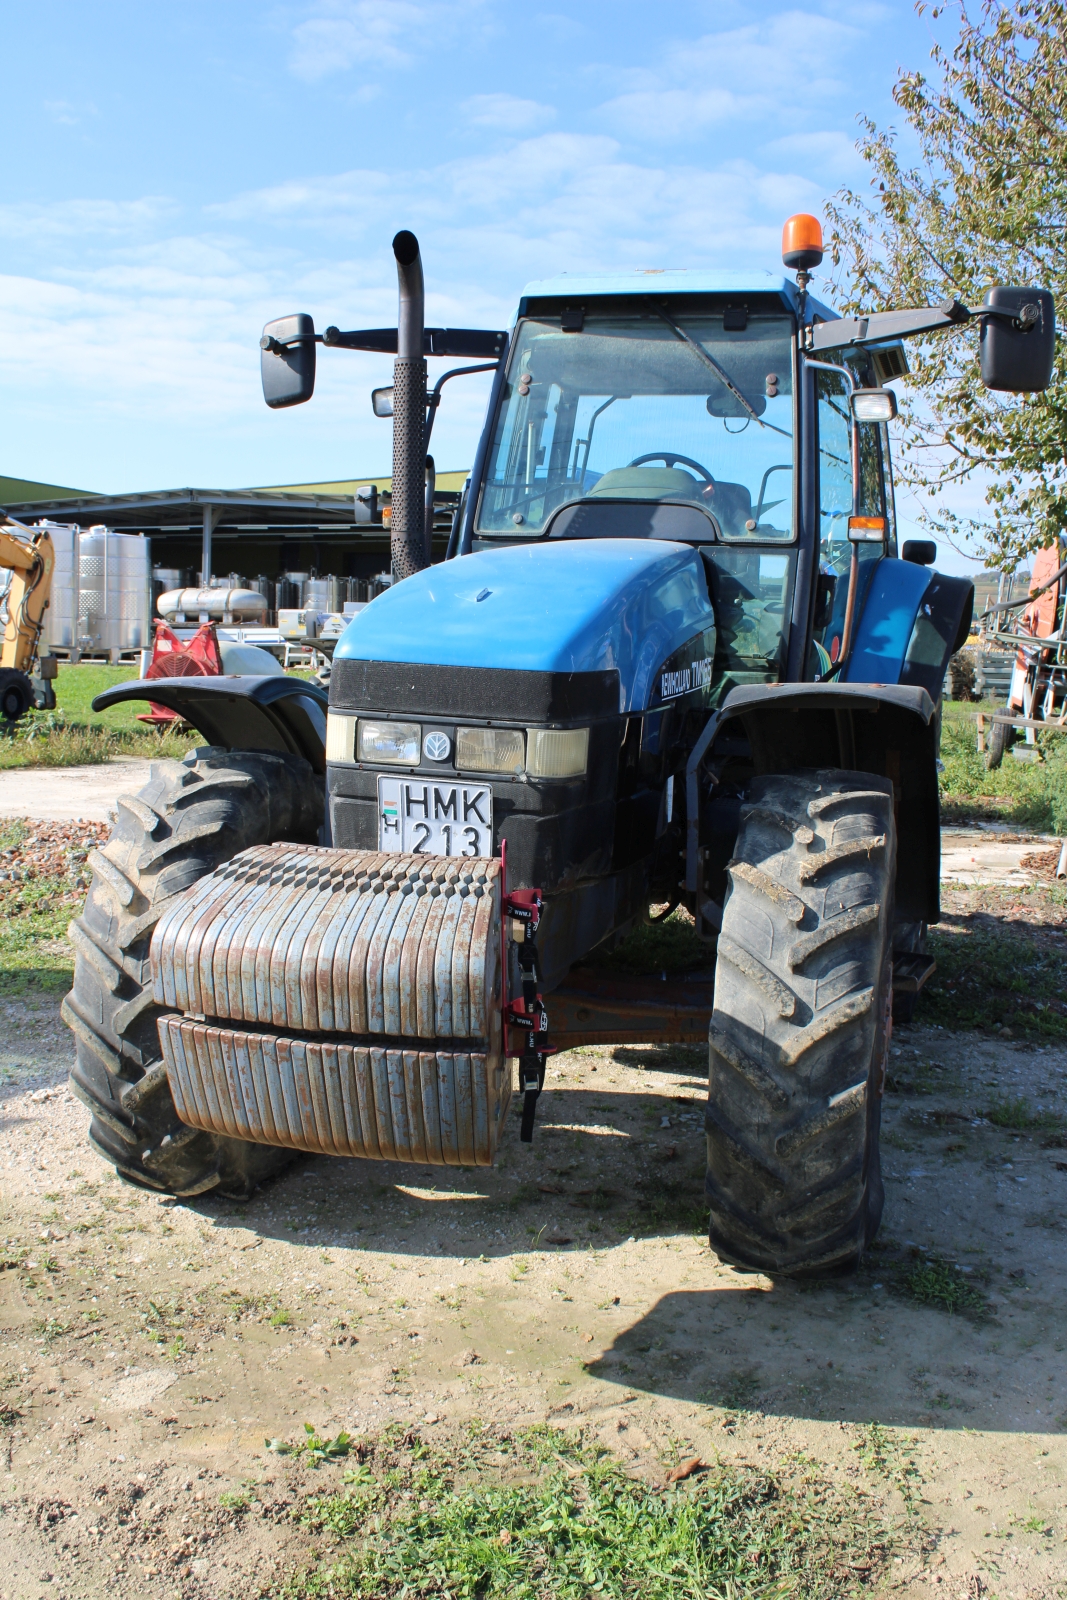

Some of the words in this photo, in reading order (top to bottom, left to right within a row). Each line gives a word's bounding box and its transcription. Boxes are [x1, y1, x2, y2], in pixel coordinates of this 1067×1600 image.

[405, 785, 486, 824] HMK
[383, 816, 398, 835] H
[412, 822, 480, 857] 213
